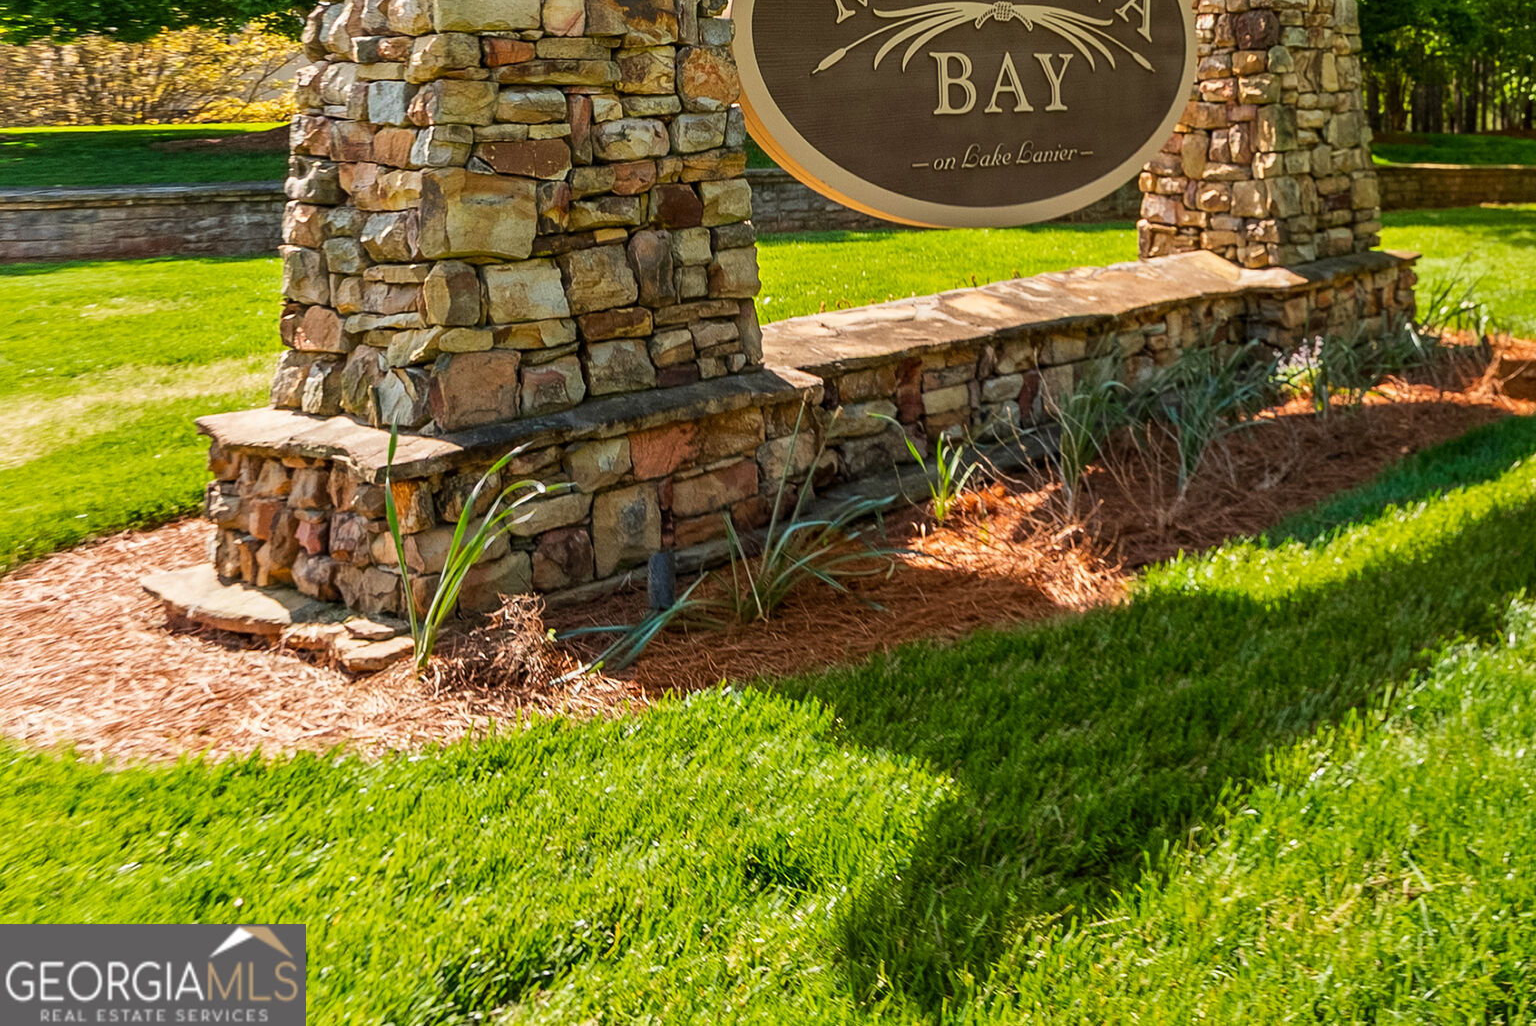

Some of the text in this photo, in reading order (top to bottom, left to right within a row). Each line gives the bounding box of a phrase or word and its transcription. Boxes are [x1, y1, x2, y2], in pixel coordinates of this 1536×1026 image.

[929, 51, 1075, 116] BAY
[933, 140, 1079, 171] on Lake Lanier
